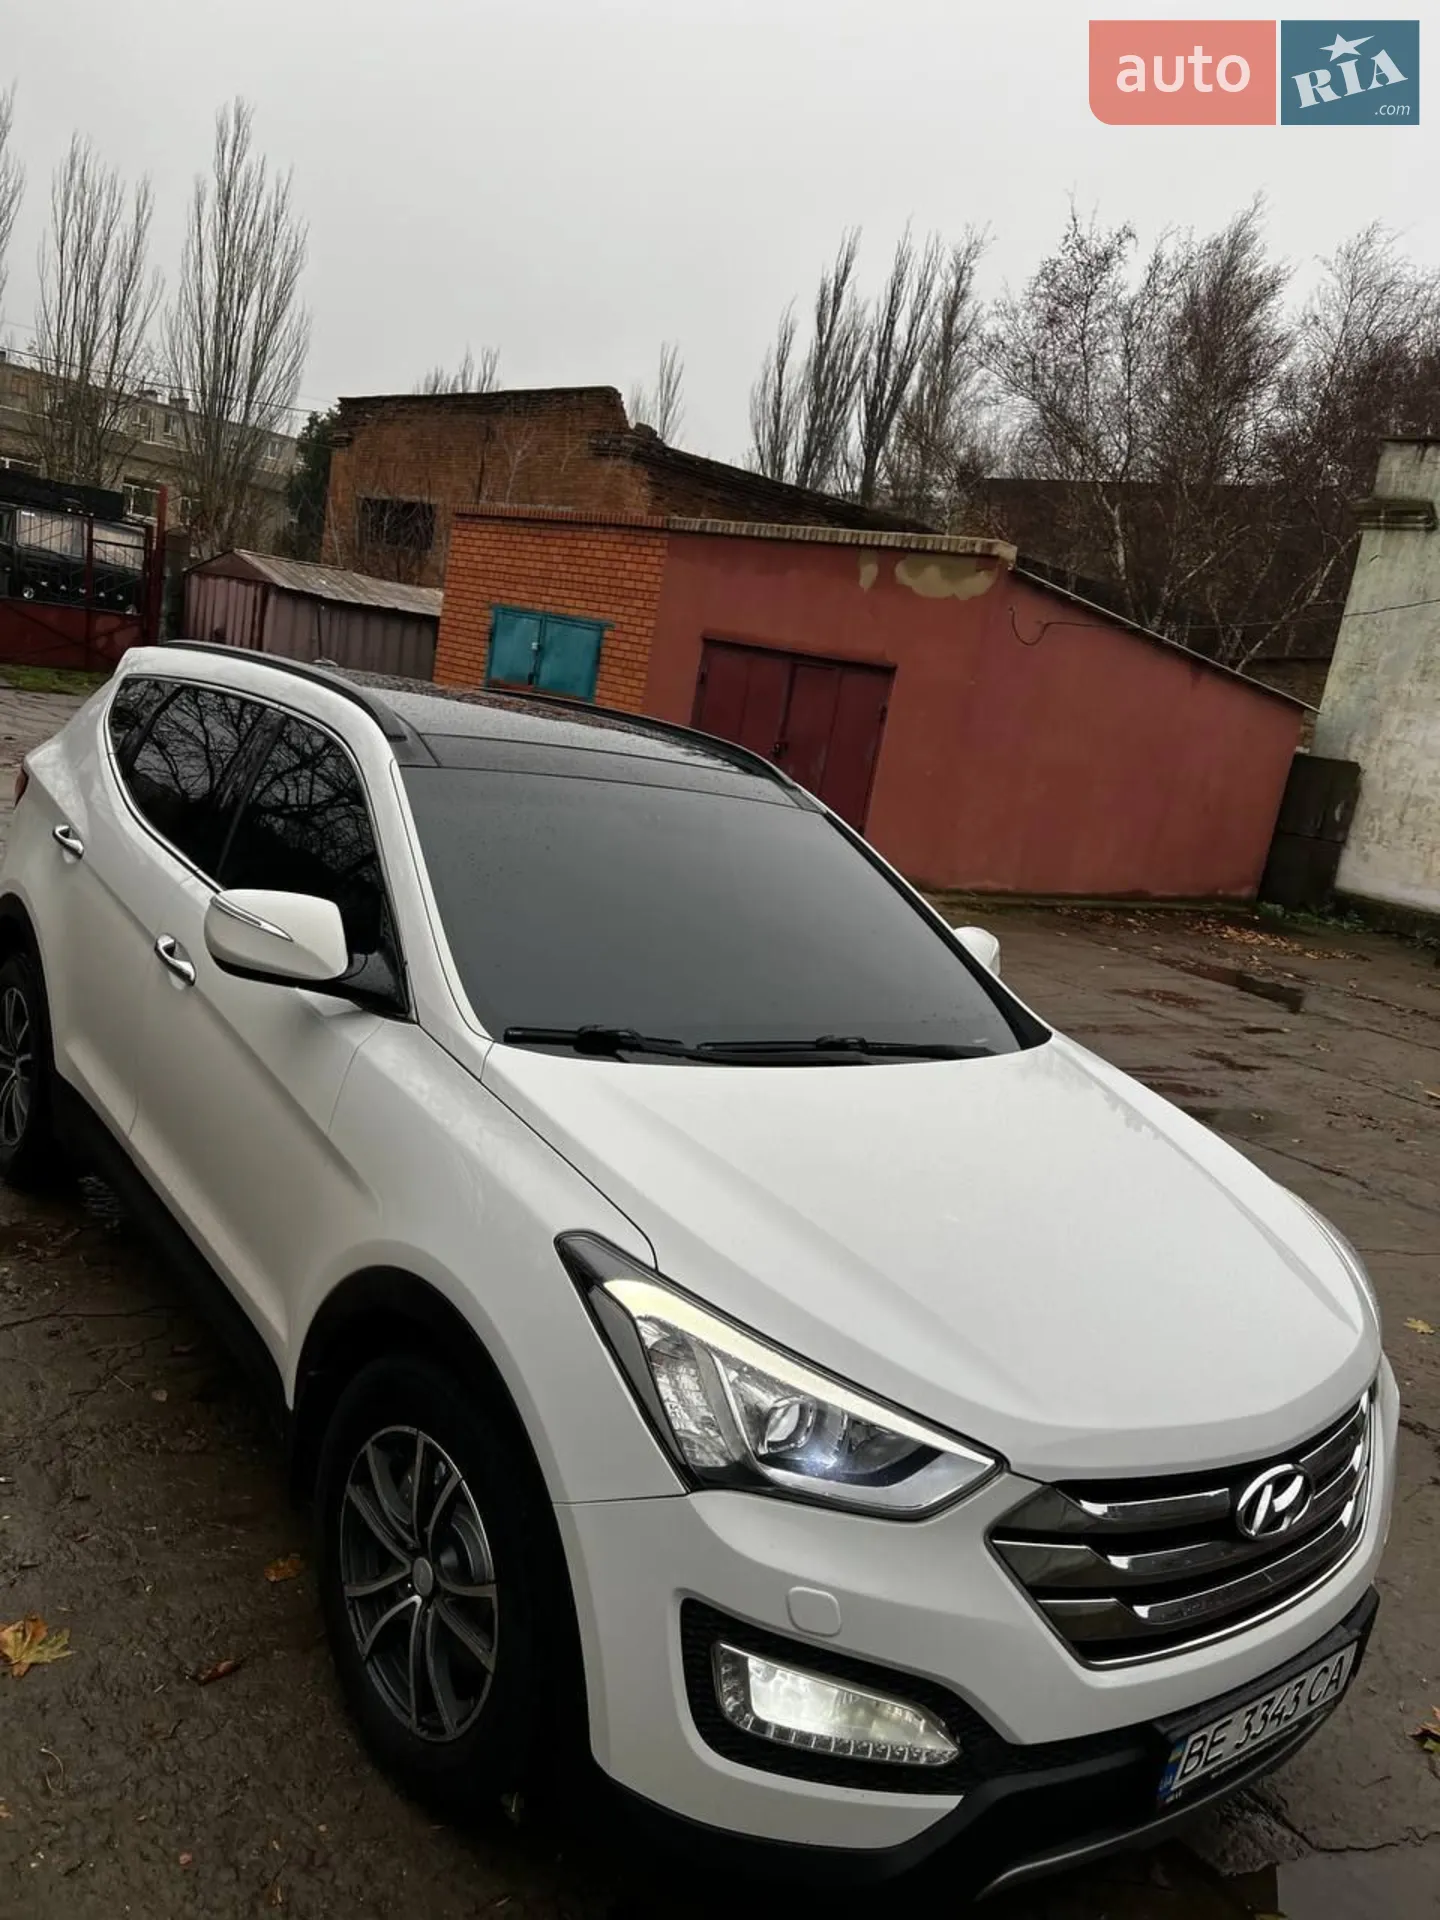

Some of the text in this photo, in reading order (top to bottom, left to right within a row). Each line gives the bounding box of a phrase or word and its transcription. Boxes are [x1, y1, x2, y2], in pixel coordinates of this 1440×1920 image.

[1179, 1718, 1232, 1781] BE
[1234, 1677, 1307, 1748] 3343
[1307, 1655, 1346, 1706] CA
